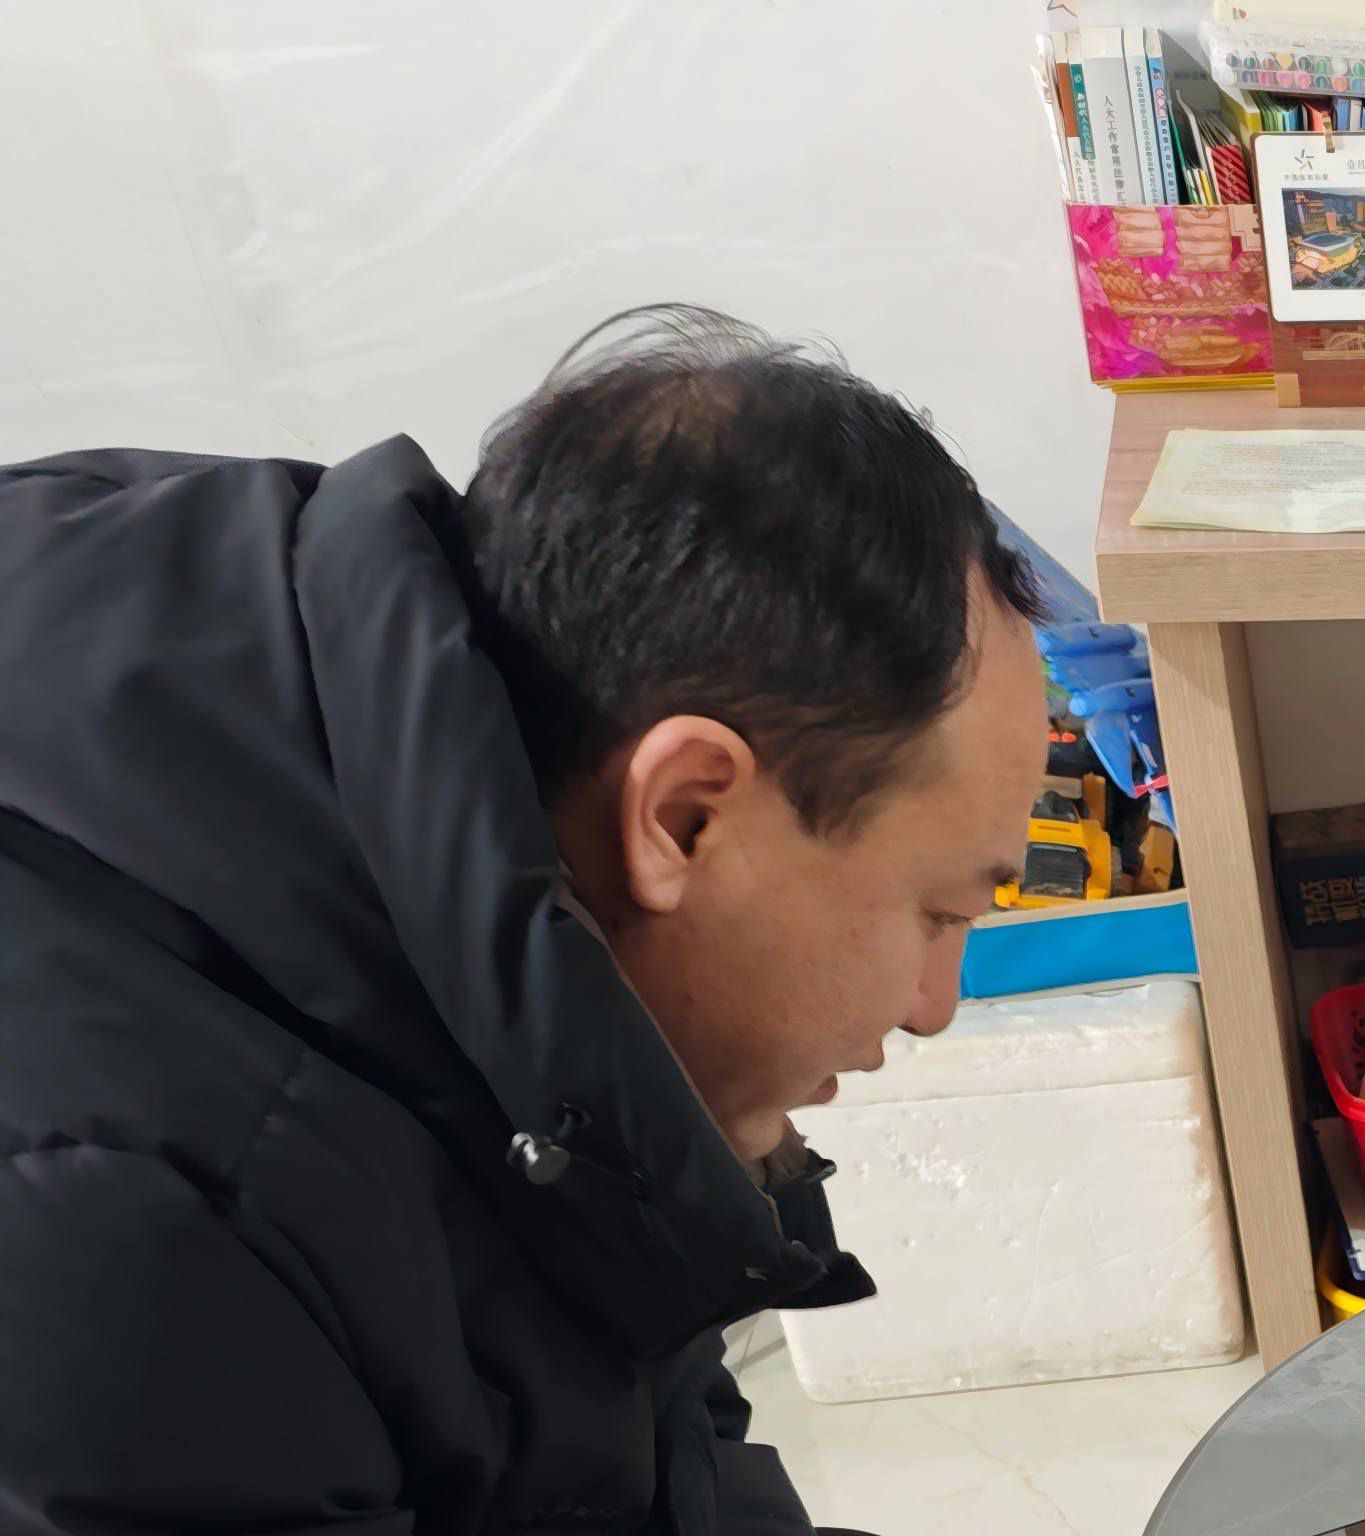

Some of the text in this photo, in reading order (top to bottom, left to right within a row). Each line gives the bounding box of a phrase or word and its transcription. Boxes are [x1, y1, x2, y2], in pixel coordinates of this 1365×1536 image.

[1103, 95, 1128, 205] 人大工作常用法律汇
